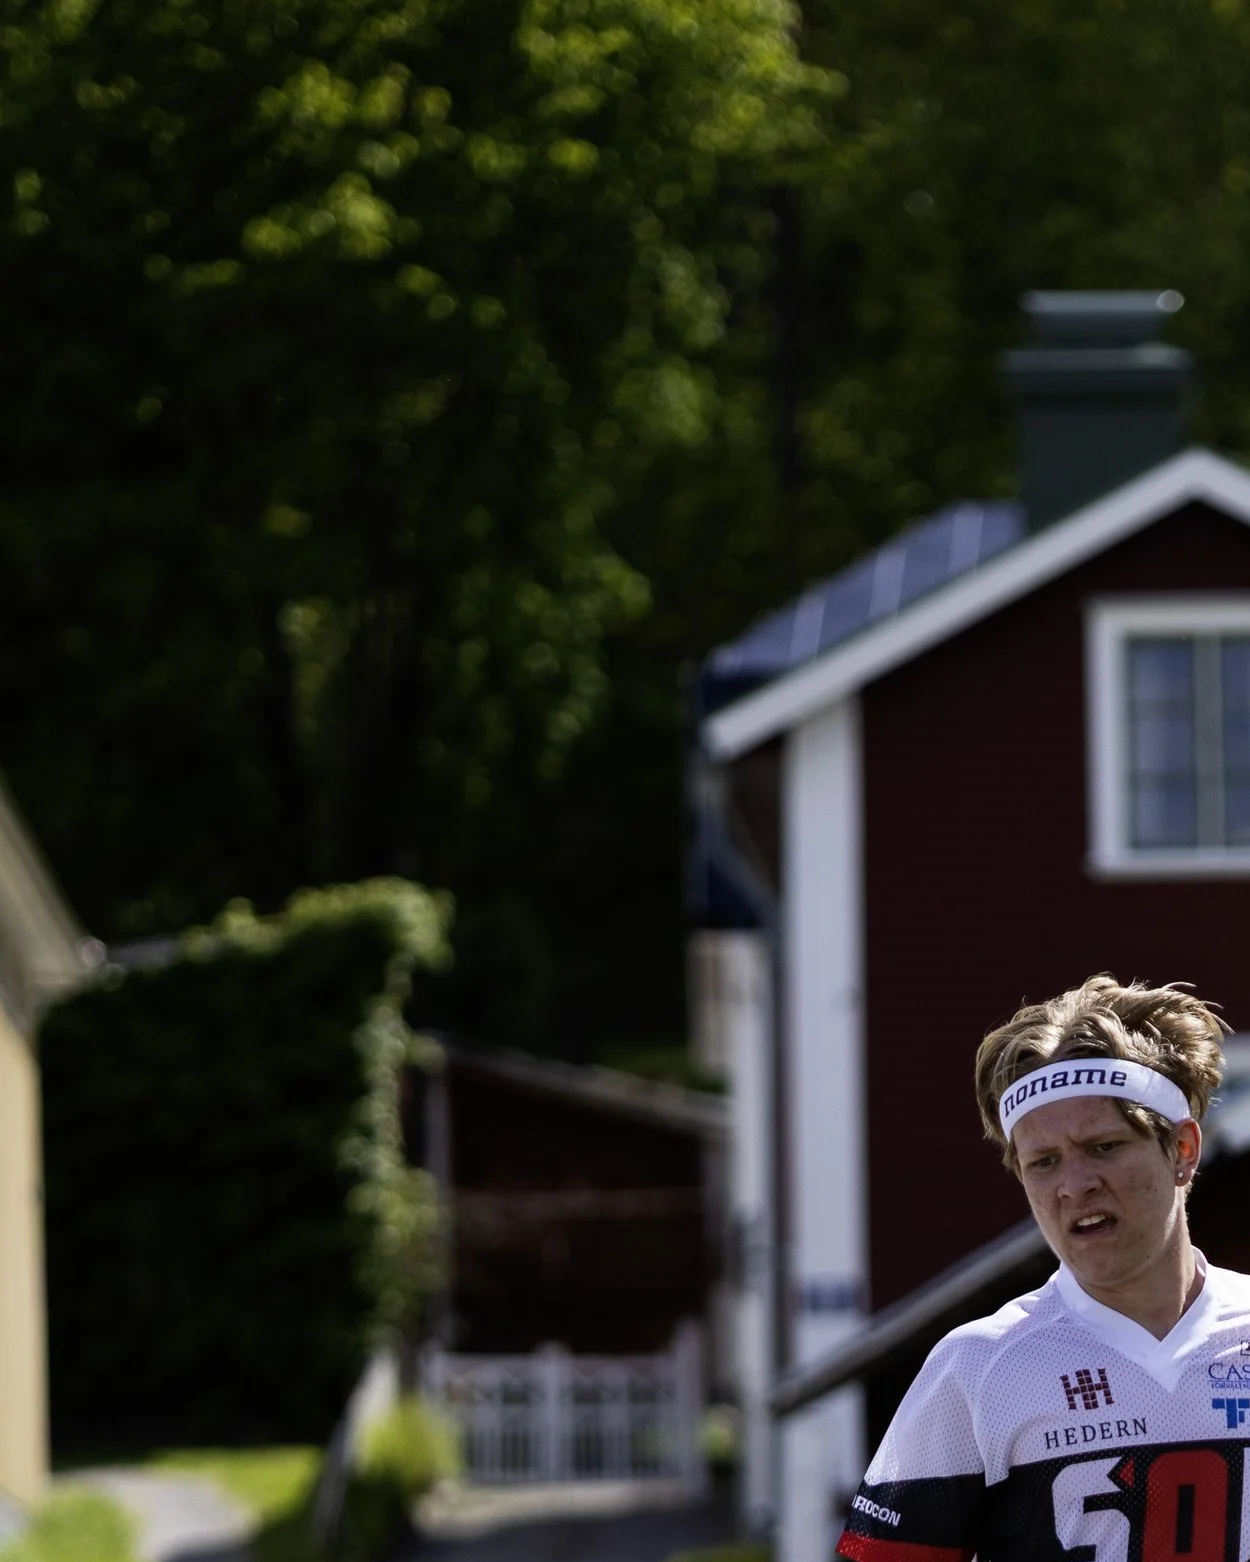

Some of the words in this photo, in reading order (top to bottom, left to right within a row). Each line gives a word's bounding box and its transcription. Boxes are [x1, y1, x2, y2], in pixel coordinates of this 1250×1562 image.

[1004, 1068, 1127, 1118] noname
[1044, 1417, 1148, 1450] HEDERN
[852, 1494, 902, 1527] ROCON
